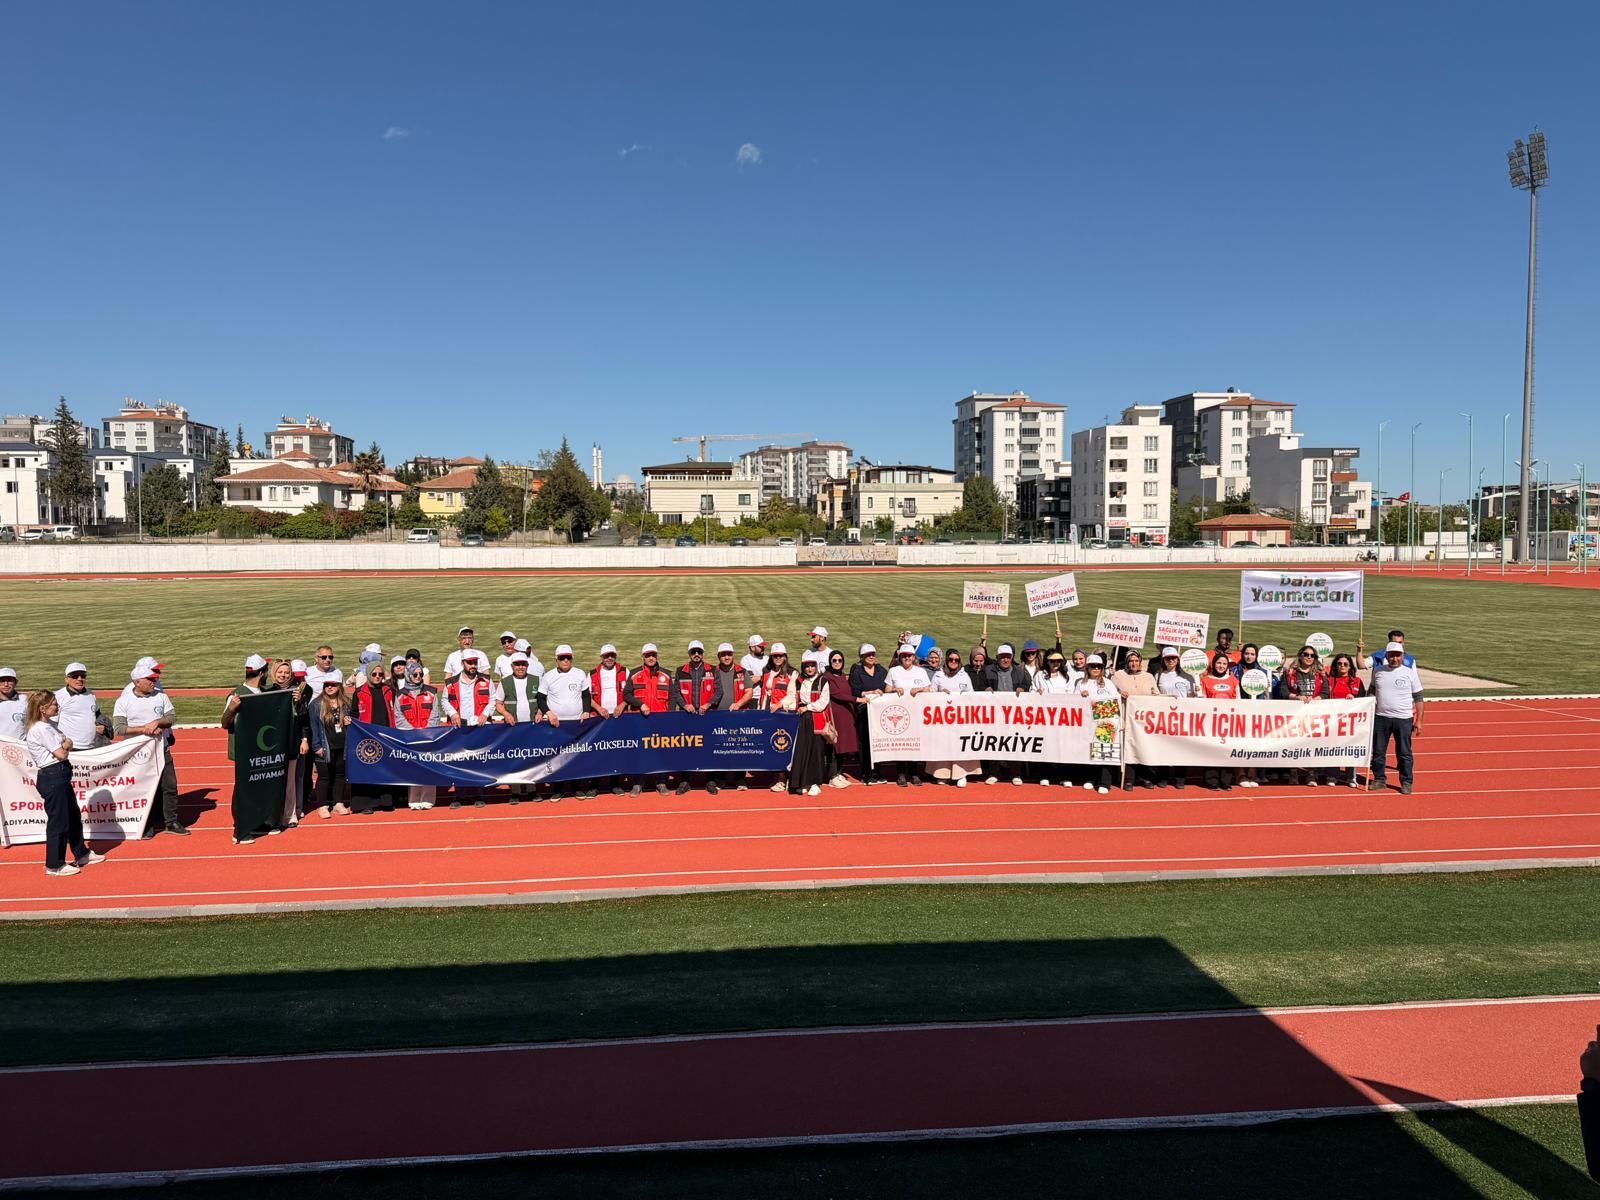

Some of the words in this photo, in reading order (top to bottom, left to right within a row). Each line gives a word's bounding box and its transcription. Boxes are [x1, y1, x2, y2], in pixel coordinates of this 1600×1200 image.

[1251, 586, 1355, 602] Yanmadan
[1103, 622, 1139, 633] YAŞAMINA
[1096, 631, 1128, 641] HAREKET
[1128, 635, 1142, 643] KAT
[923, 700, 995, 725] SAĞLIKLI
[1002, 705, 1083, 730] YAŞAYAN
[712, 727, 727, 735] Aile
[1212, 707, 1246, 744] İÇİN
[1251, 713, 1331, 738] HAREKET
[418, 752, 470, 762] KÖKLENEN
[506, 747, 558, 760] GÜÇLENEN
[593, 739, 639, 751] YÜKSELEN
[641, 732, 704, 749] TÜRKİYE
[960, 731, 1044, 753] TÜRKİYE
[1230, 748, 1279, 760] Adıyaman
[1281, 747, 1311, 760] Sağlık
[1314, 746, 1366, 758] Müdürlüğü
[93, 776, 135, 787] YAŞAM
[3, 818, 46, 827] ADIYAMAN
